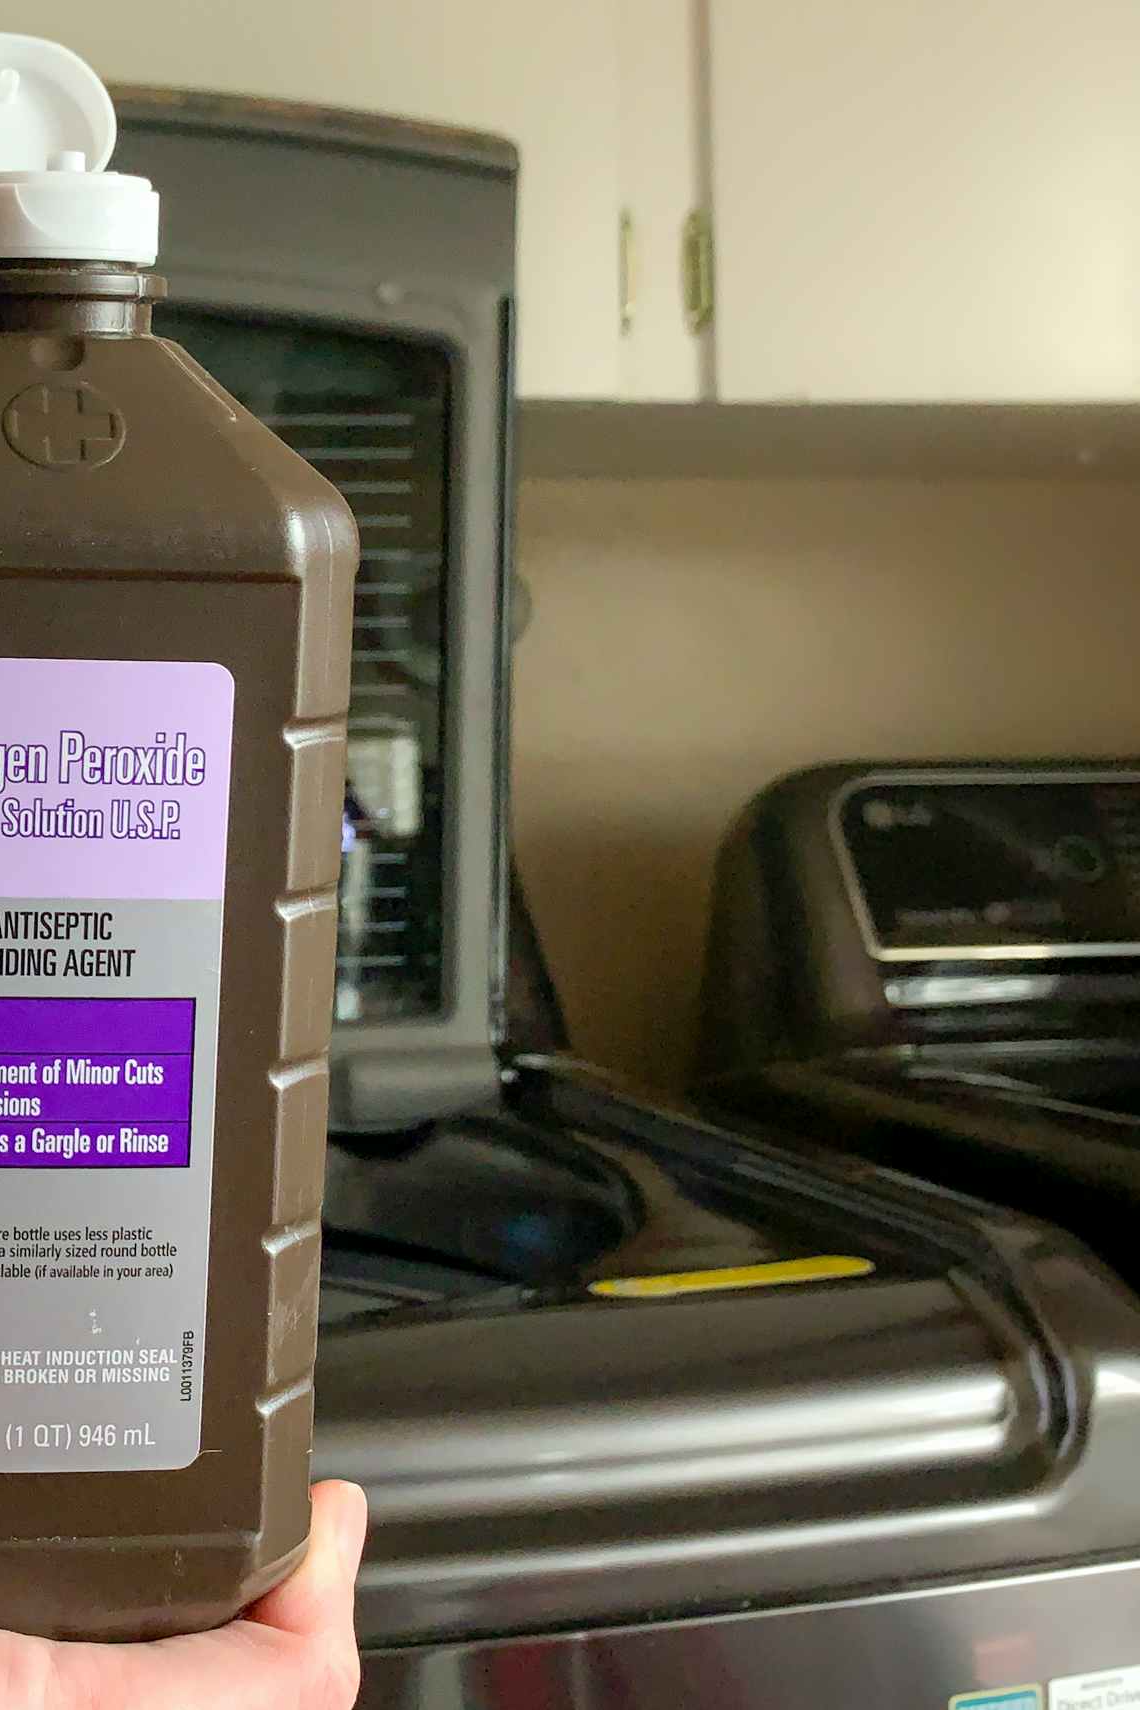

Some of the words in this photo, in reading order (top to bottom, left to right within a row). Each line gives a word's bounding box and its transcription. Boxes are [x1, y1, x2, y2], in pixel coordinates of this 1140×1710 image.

[59, 730, 205, 785] Peroxide
[2, 797, 104, 839] Solution
[110, 799, 181, 840] U.S.P.
[63, 949, 136, 977] AGENT
[42, 1058, 61, 1085] of
[66, 1059, 120, 1085] Minor
[124, 1059, 164, 1085] Cuts
[14, 1133, 26, 1153] a
[31, 1128, 90, 1159] Gargle
[96, 1133, 114, 1153] or
[119, 1128, 169, 1153] Rinse
[13, 1226, 50, 1241] bottle
[54, 1230, 81, 1241] uses
[85, 1226, 108, 1241] less
[112, 1226, 153, 1244] plastic
[9, 1244, 61, 1261] similarly
[65, 1244, 97, 1258] sized
[100, 1243, 137, 1258] round
[140, 1242, 177, 1257] bottle
[34, 1265, 47, 1280] (if
[50, 1265, 100, 1278] available
[103, 1265, 114, 1278] in
[117, 1266, 142, 1280] your
[144, 1264, 173, 1279] area)
[1, 1350, 42, 1366] HEAT
[46, 1350, 133, 1366] INDUCTION
[139, 1349, 178, 1364] SEAL
[180, 1330, 194, 1402] L0011379FB
[4, 1369, 69, 1384] BROKEN
[74, 1368, 97, 1384] OR
[102, 1367, 170, 1383] MISSING
[5, 1423, 23, 1451] (1
[33, 1423, 72, 1450] QT)
[79, 1424, 117, 1448] 946
[123, 1422, 156, 1446] mL
